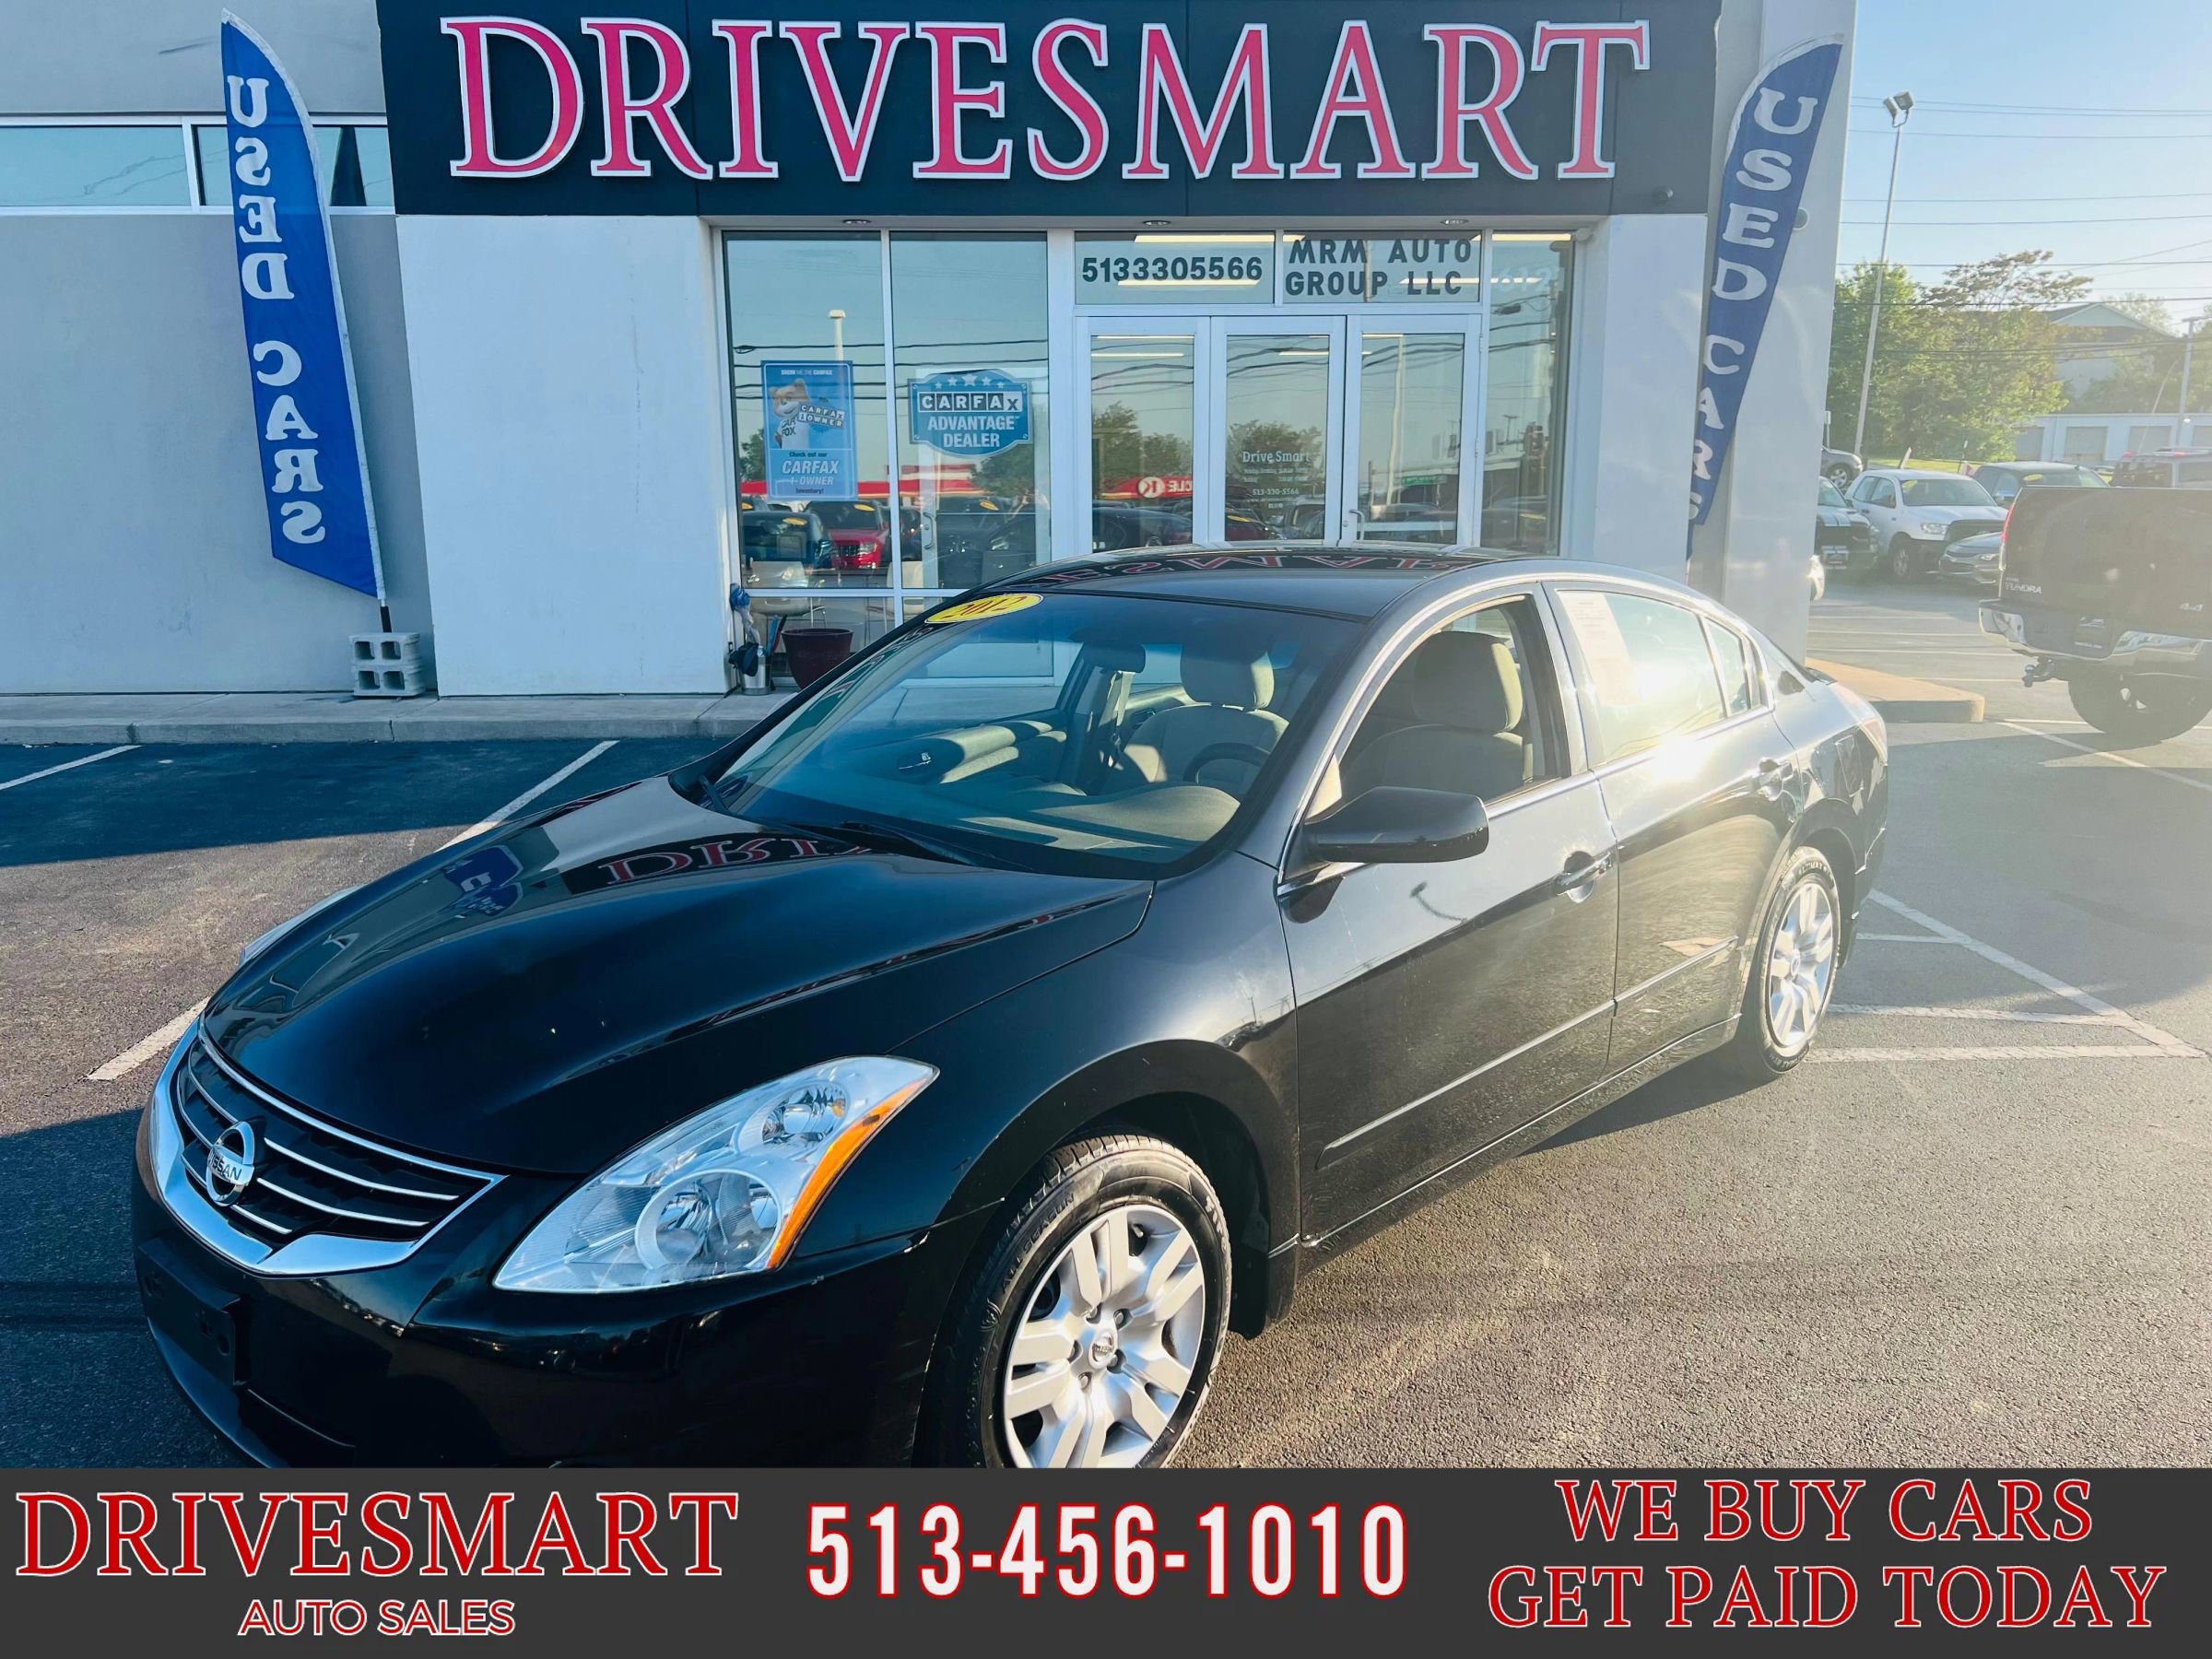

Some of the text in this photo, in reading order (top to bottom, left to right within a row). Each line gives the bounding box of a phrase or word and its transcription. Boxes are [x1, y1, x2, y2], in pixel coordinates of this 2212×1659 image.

[441, 17, 1650, 182] DRIVESMART
[1712, 87, 1818, 301] USED
[1288, 239, 1471, 264] MRM AUTO
[1082, 257, 1263, 283] 5133305566
[1285, 271, 1462, 296] GROUP LLC
[920, 393, 1020, 411] CARFAX
[801, 405, 845, 420] CARFAX
[927, 416, 1016, 430] ADVANTAGE
[943, 433, 1000, 448] DEALER
[1242, 450, 1310, 463] Drive Smart
[782, 460, 840, 475] CARFAX
[1253, 488, 1300, 496] 513-330-5566
[939, 595, 1029, 619] 2012
